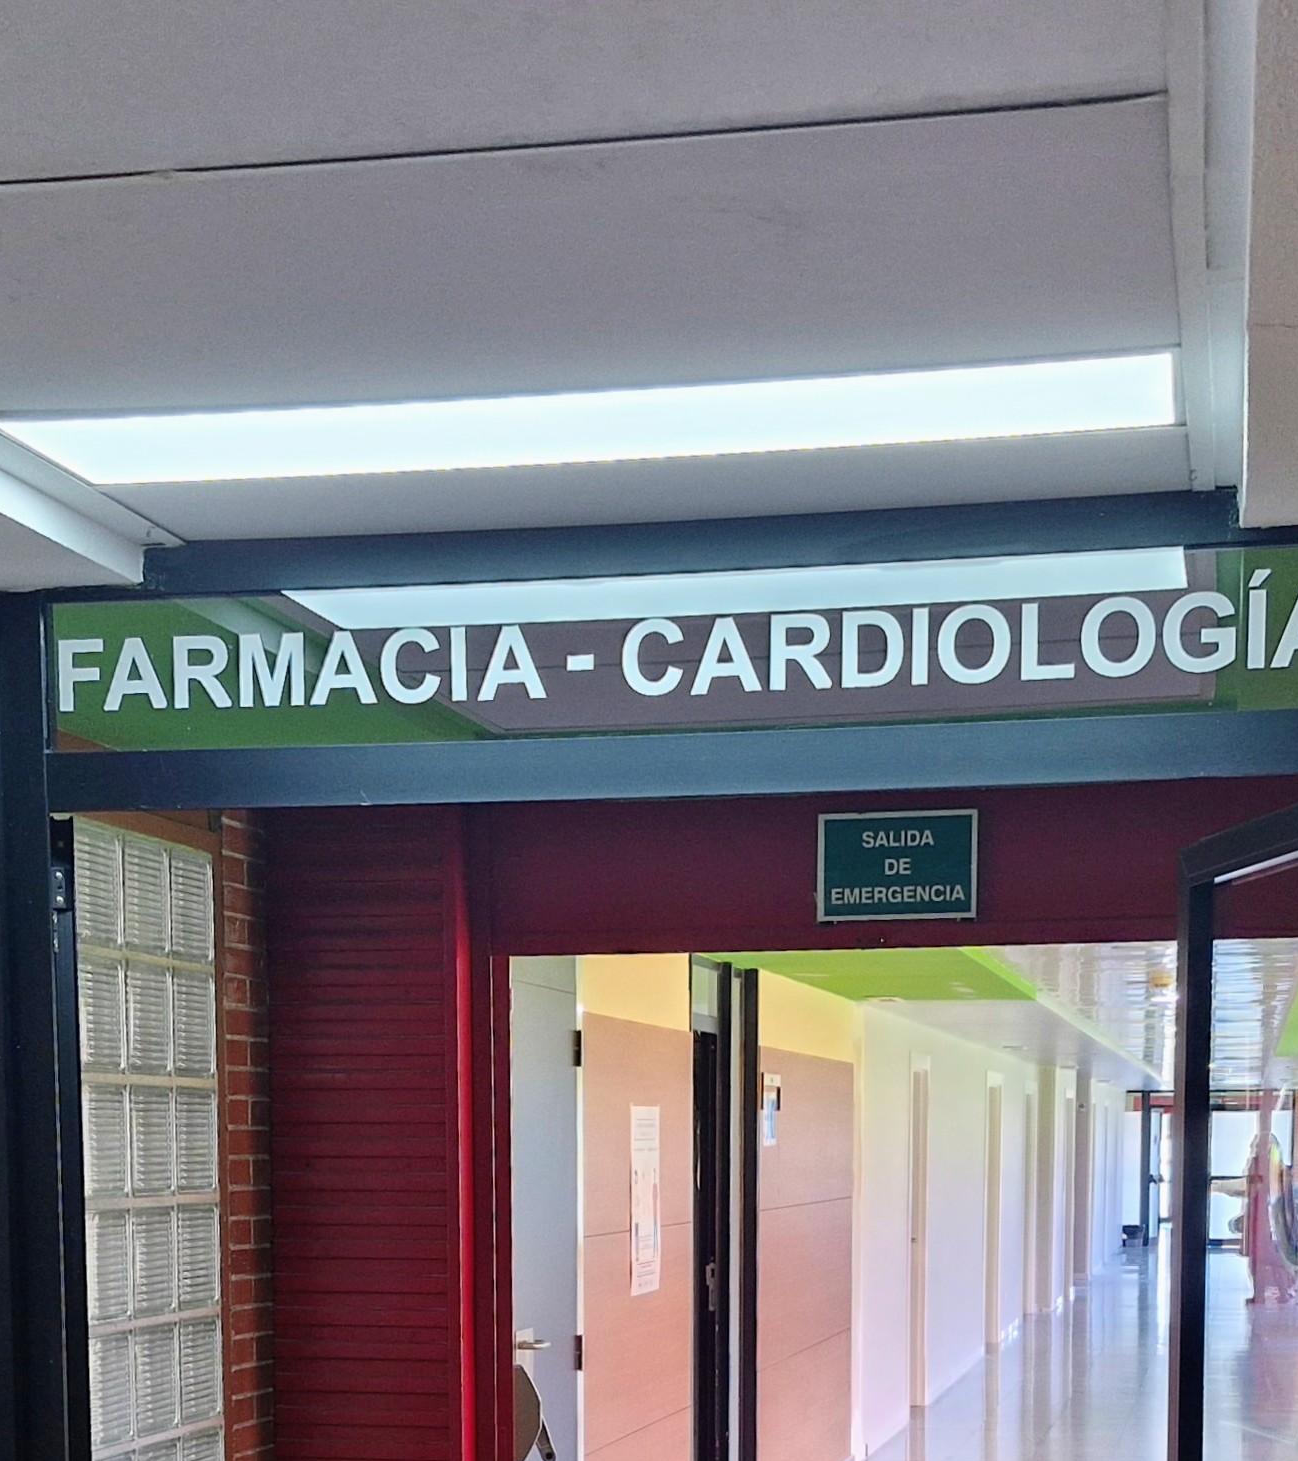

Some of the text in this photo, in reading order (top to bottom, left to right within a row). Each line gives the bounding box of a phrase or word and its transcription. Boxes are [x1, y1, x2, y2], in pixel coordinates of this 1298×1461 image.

[56, 624, 548, 713] FARMACIA
[565, 653, 596, 672] -
[861, 829, 935, 849] SALIDA
[883, 858, 912, 876] DE
[830, 884, 966, 905] EMERGENCIA
